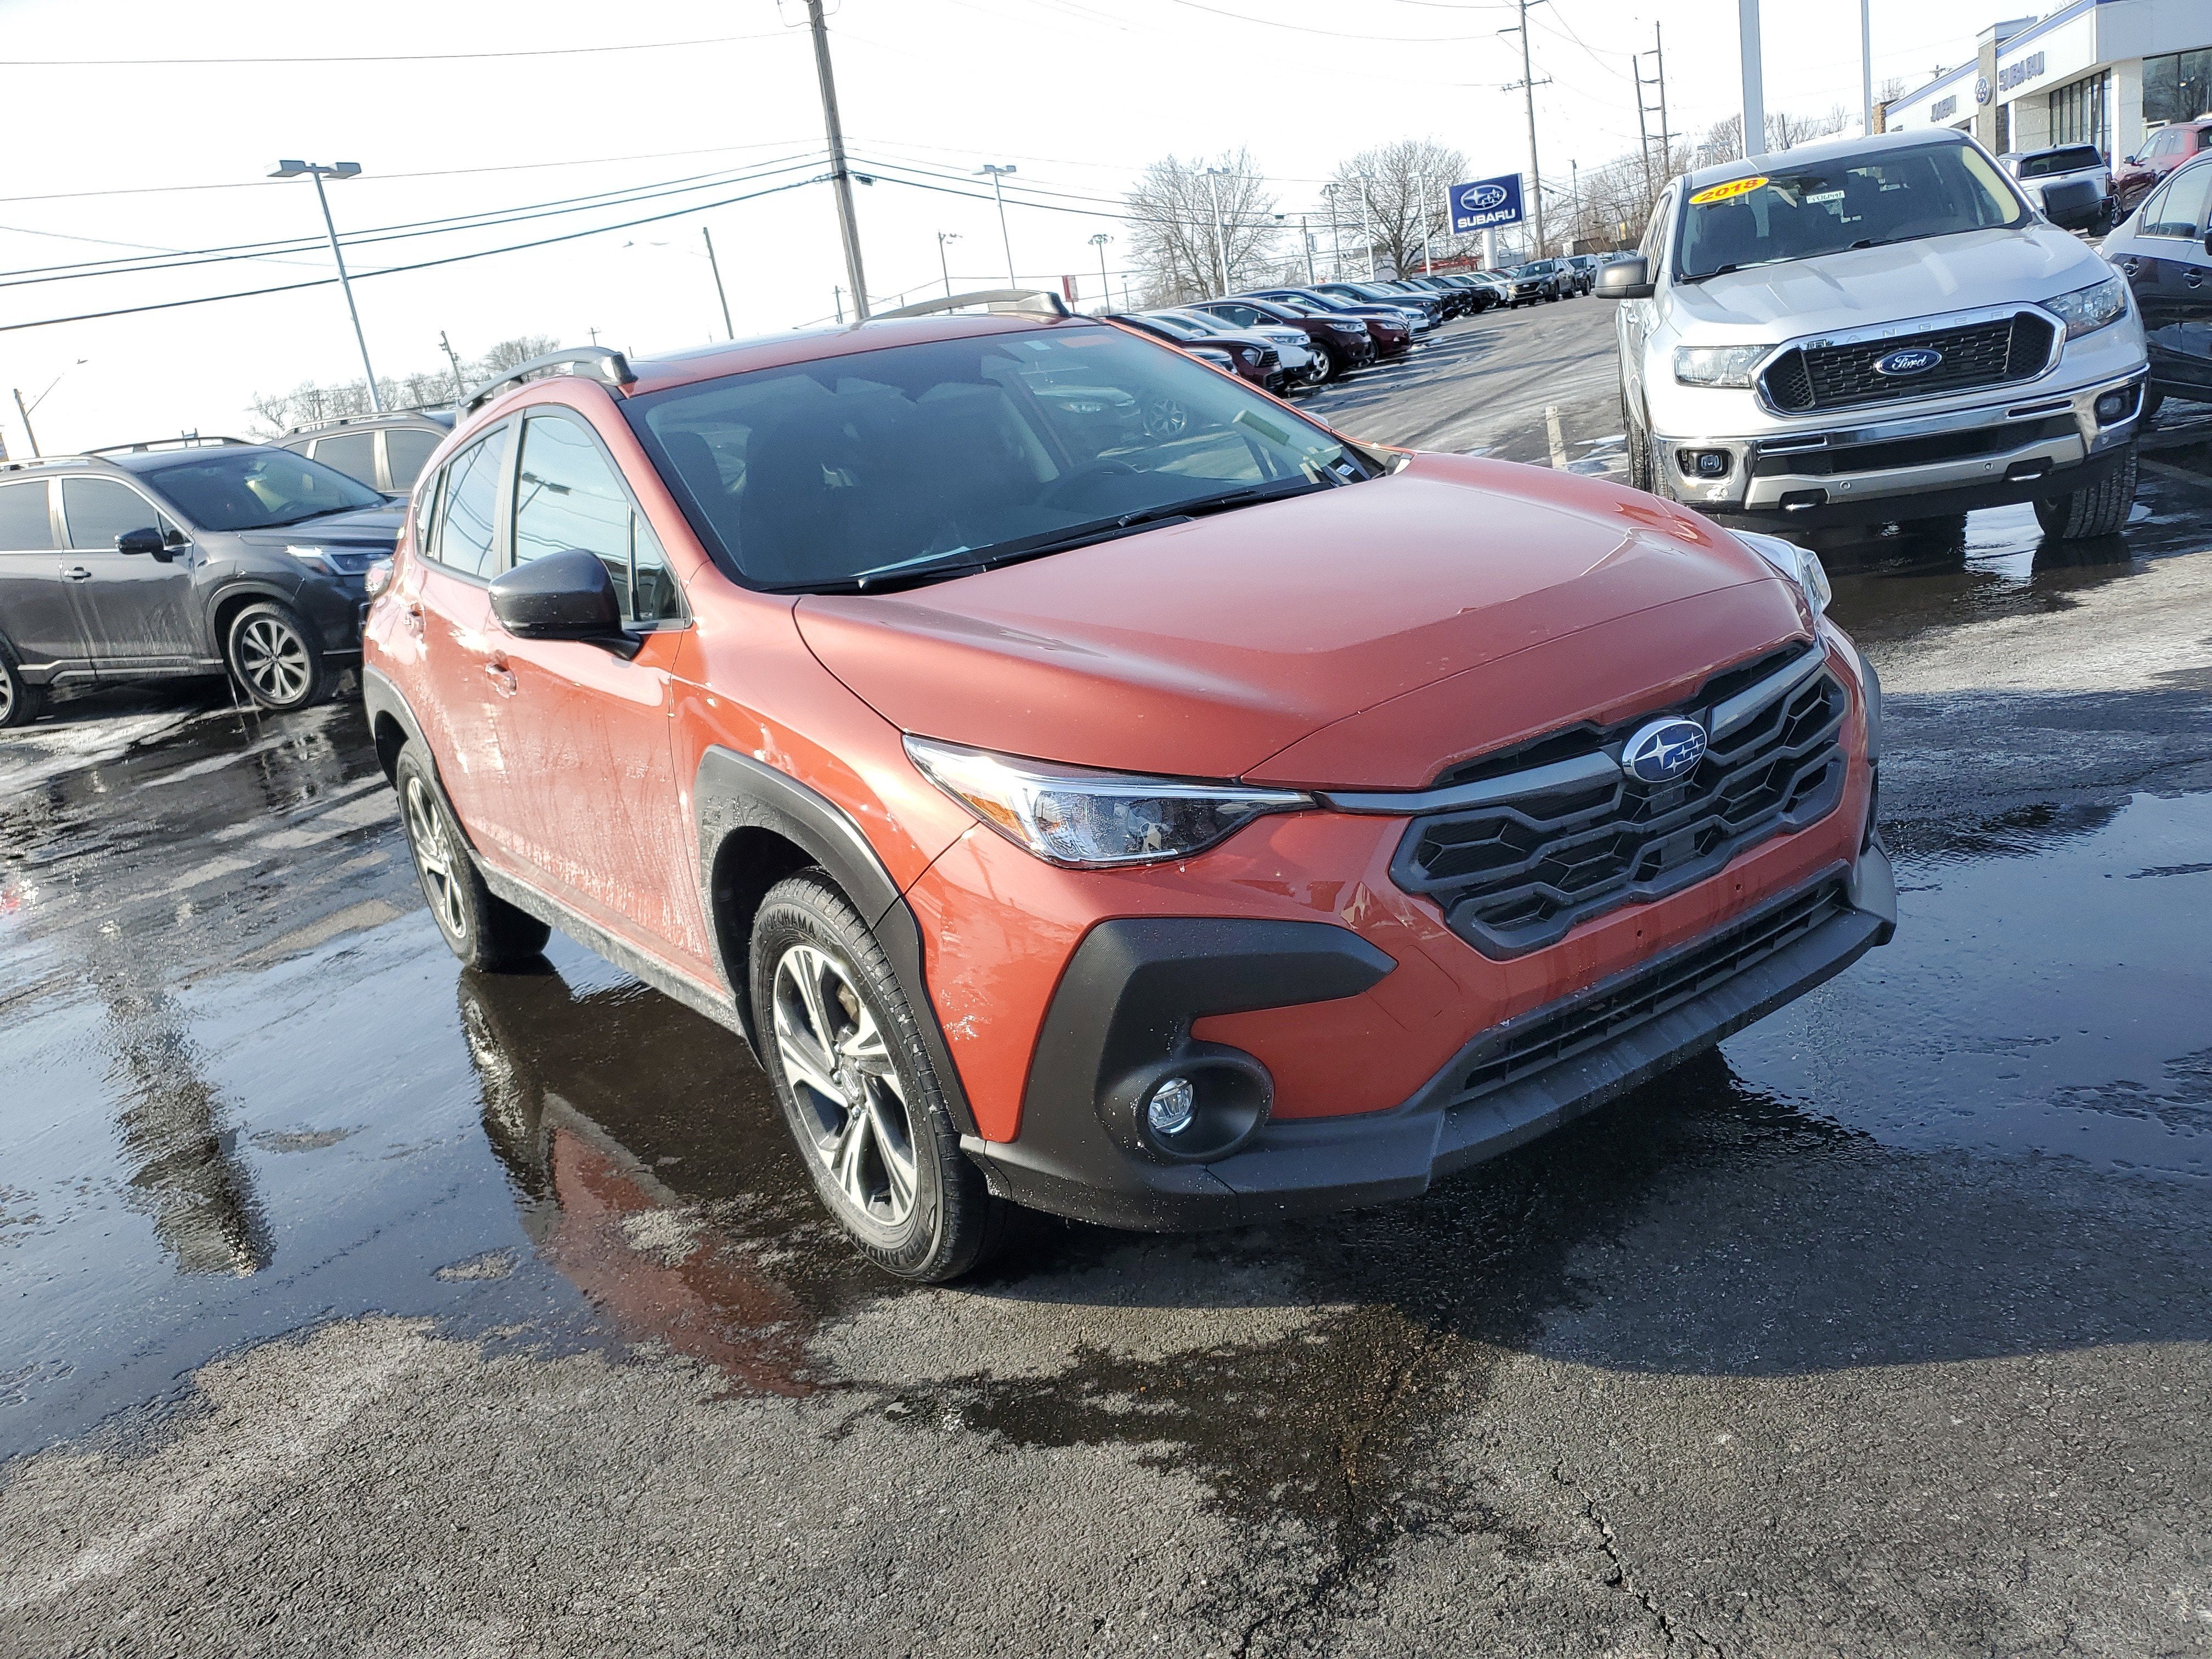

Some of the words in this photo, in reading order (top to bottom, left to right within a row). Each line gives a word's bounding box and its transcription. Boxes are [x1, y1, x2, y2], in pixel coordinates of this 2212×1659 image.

[1999, 51, 2045, 92] SUBARU
[1700, 179, 1759, 202] 2018
[1457, 208, 1516, 228] SUBARU
[1892, 353, 1927, 370] Ford
